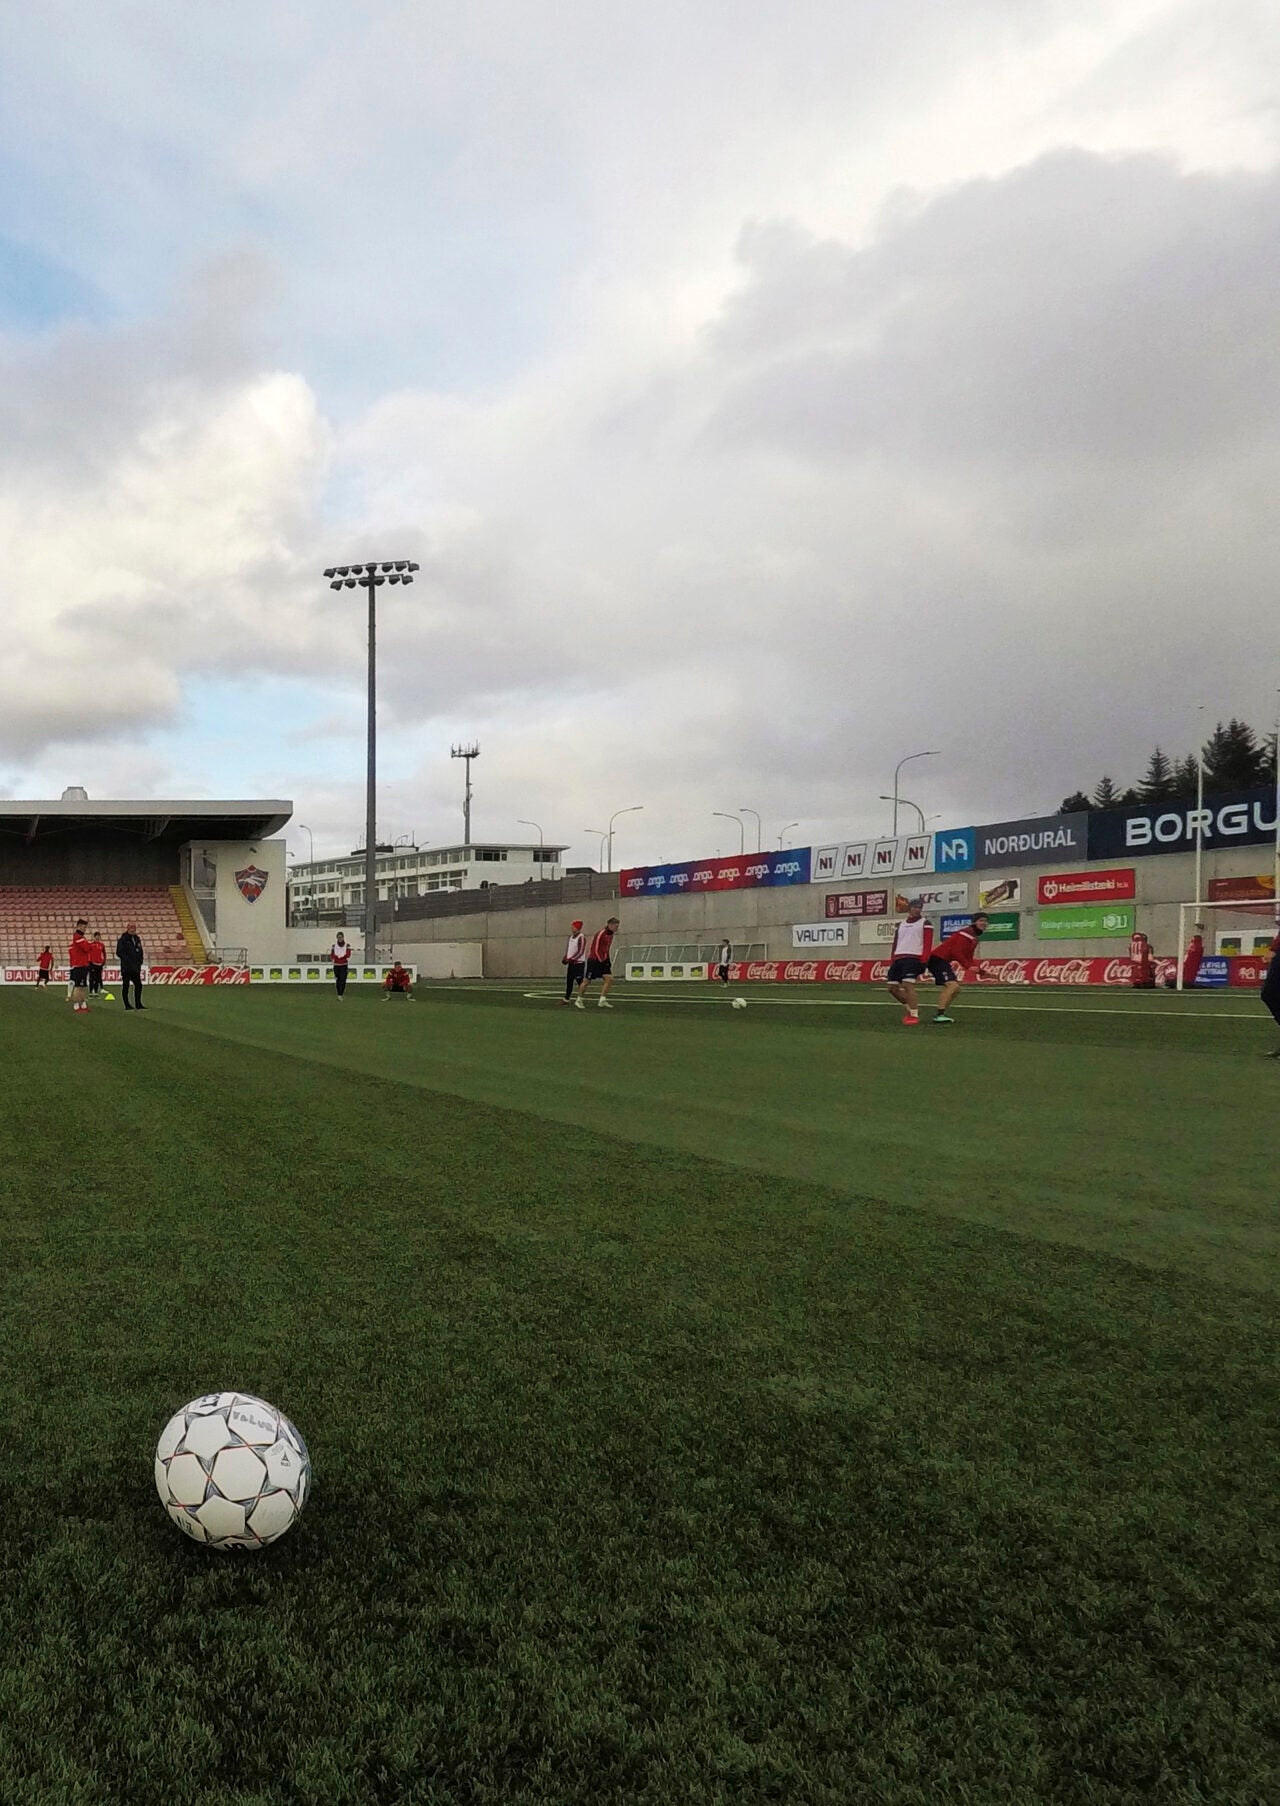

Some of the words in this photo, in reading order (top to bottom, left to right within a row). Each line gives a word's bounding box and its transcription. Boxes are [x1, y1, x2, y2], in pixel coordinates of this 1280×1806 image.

[984, 825, 1077, 856] NORÐURÁL
[847, 853, 861, 867] N1
[877, 850, 892, 864] N1
[908, 846, 924, 860] N1
[820, 857, 833, 870] N1
[919, 892, 944, 903] KFC
